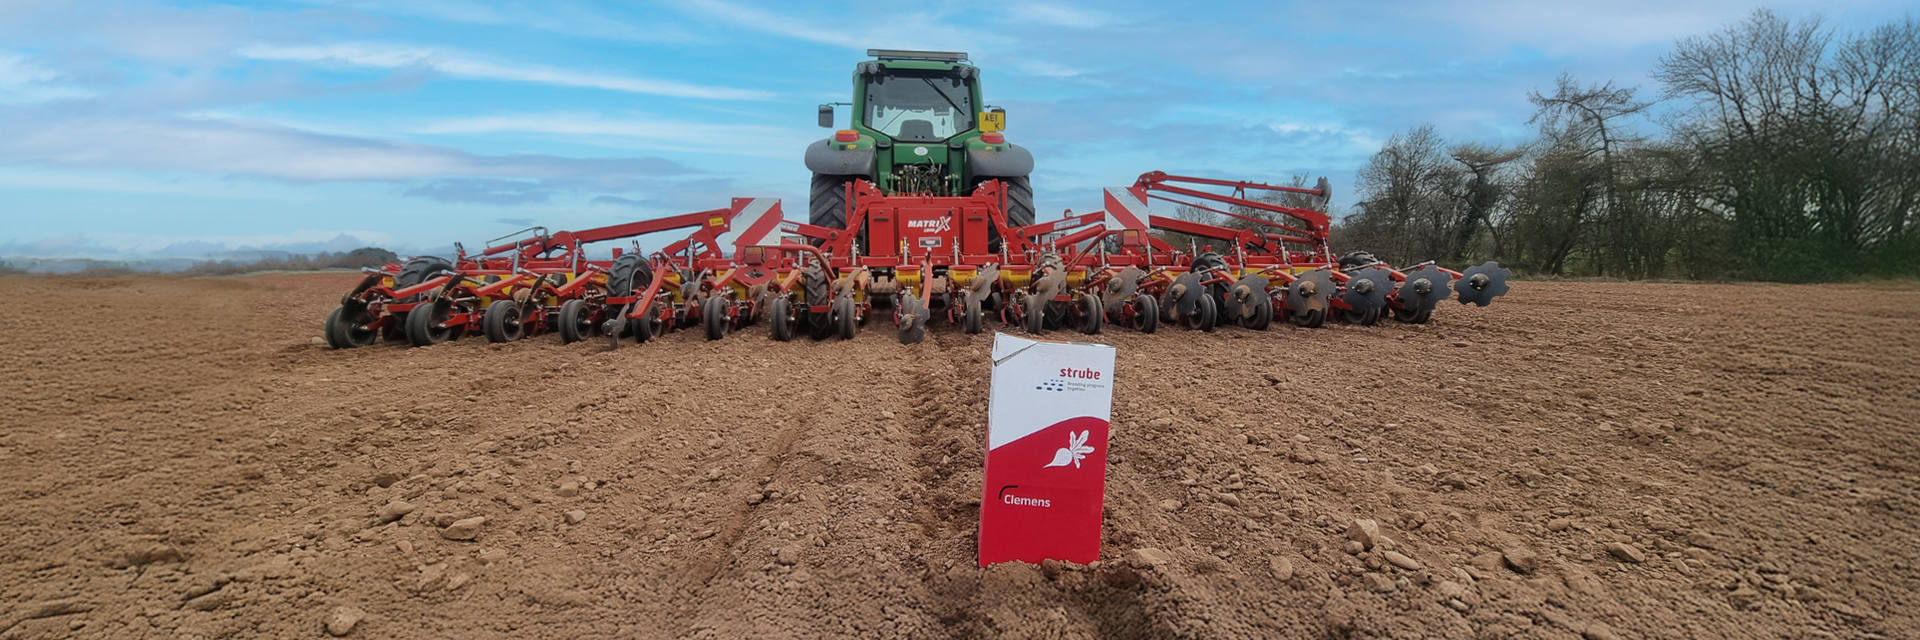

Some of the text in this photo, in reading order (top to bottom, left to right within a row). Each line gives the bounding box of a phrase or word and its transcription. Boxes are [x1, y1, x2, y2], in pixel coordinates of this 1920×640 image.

[908, 216, 951, 234] MATRIX
[1060, 367, 1101, 380] strube
[1004, 494, 1051, 508] Clemens
